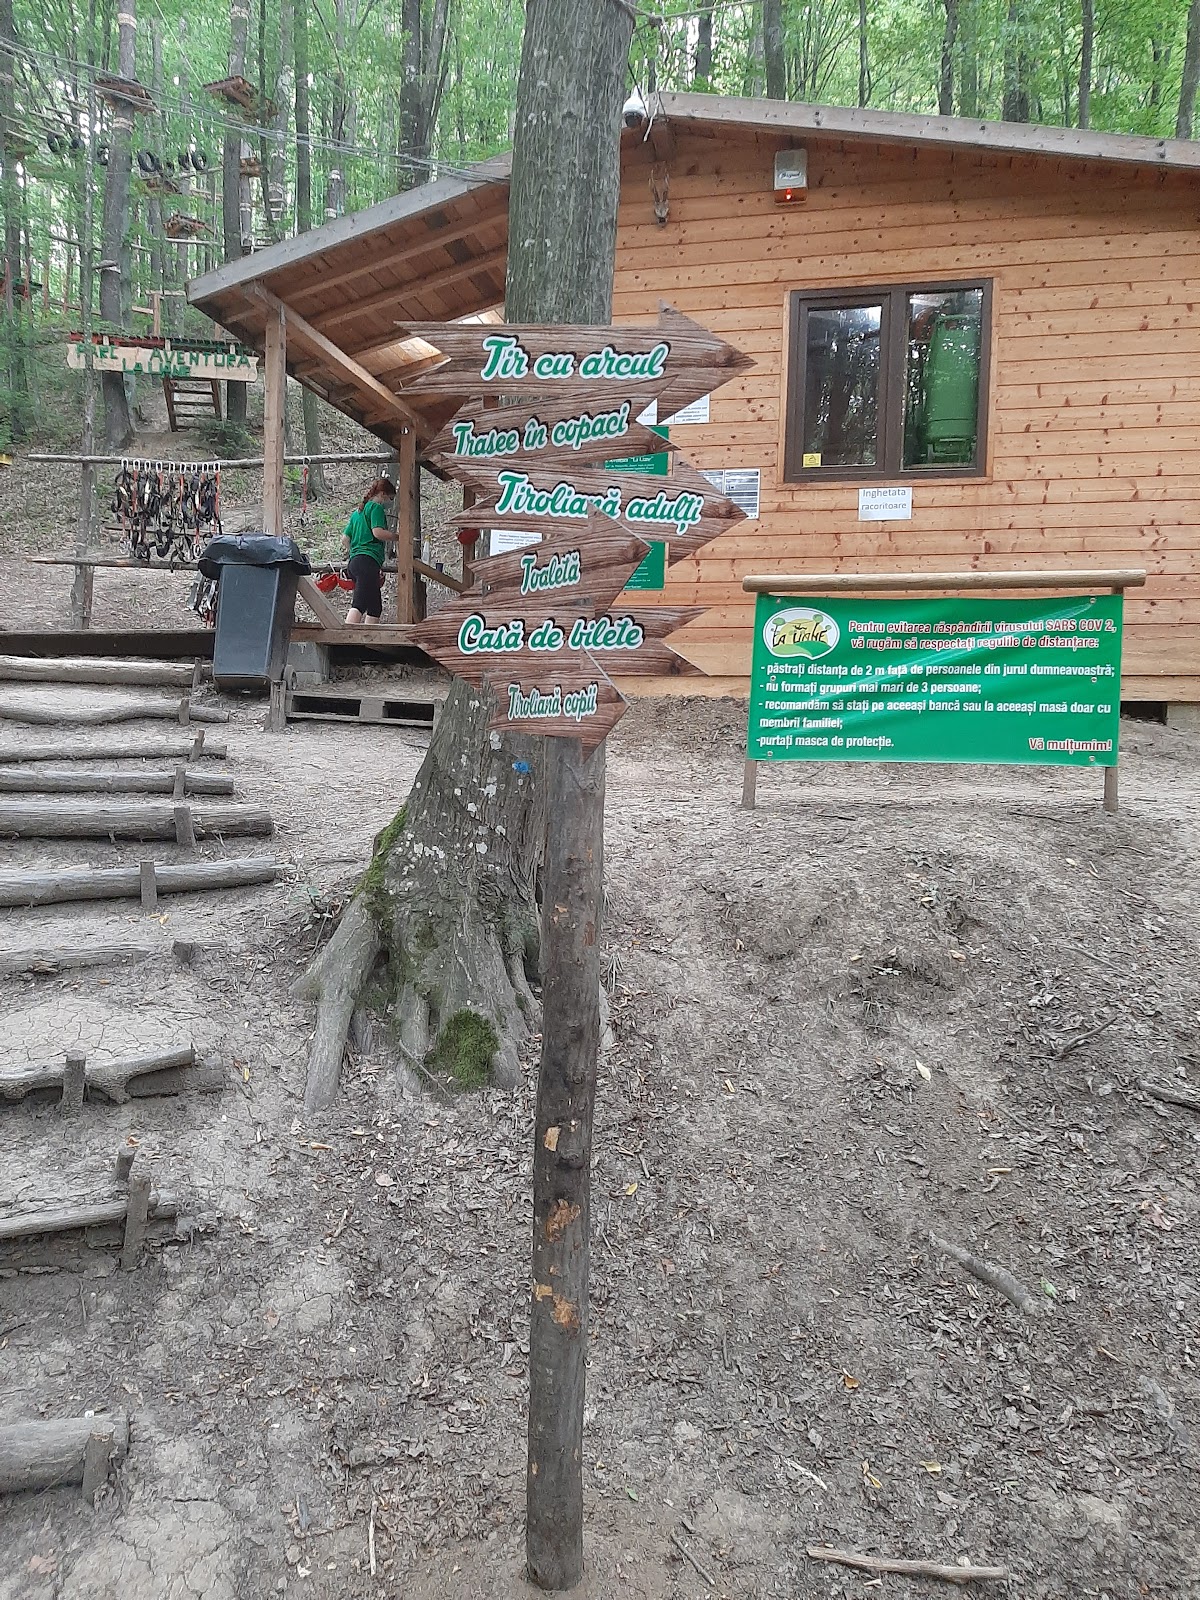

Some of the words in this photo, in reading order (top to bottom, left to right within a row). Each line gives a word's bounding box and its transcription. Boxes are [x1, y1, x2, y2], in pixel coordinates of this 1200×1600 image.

[150, 347, 251, 368] AVENTURA
[482, 337, 529, 380] Tir
[533, 353, 576, 379] cu
[579, 343, 667, 379] arcul
[453, 420, 519, 457] Trasee
[523, 417, 547, 450] în
[551, 403, 631, 450] copaci
[863, 489, 906, 498] Inghetata
[625, 490, 704, 535] adulți
[862, 502, 907, 510] racoritoare
[520, 551, 580, 595] Toaletă
[458, 615, 524, 654] Casă
[528, 619, 564, 651] de
[568, 615, 643, 651] bilete
[849, 620, 884, 633] Pentru
[887, 621, 931, 633] evitarea
[933, 621, 992, 635] răspândirii
[995, 621, 1044, 632] virusului
[1046, 619, 1077, 631] SARS
[1079, 619, 1103, 631] COV
[1105, 619, 1117, 632] 2,
[772, 625, 786, 647] LA
[851, 636, 864, 649] vă
[867, 637, 902, 651] rugăm
[904, 637, 917, 649] să
[920, 637, 975, 651] respectați
[977, 636, 1020, 649] regulile
[1022, 636, 1035, 648] de
[1038, 636, 1099, 652] distanțare:
[767, 663, 805, 678] păstrați
[808, 664, 848, 679] distanța
[851, 665, 863, 675] de
[865, 665, 873, 675] 2
[875, 667, 885, 675] m
[887, 664, 907, 678] față
[910, 665, 923, 675] de
[926, 664, 981, 676] persoanele
[984, 664, 1000, 675] din
[1003, 664, 1027, 676] jurul
[1030, 664, 1115, 677] dumneavoastră;
[766, 682, 778, 691] nu
[781, 681, 817, 695] formați
[820, 682, 856, 695] grupuri
[859, 682, 878, 692] mai
[881, 682, 903, 692] mari
[906, 682, 919, 692] de
[921, 682, 928, 692] 3
[930, 682, 981, 694] persoane;
[508, 683, 561, 720] Tiroliană
[563, 683, 598, 722] copii
[765, 699, 829, 710] recomandăm
[832, 700, 844, 710] să
[846, 700, 869, 714] stați
[871, 702, 885, 712] pe
[887, 700, 926, 714] aceeași
[929, 700, 959, 711] bancă
[963, 702, 981, 711] sau
[984, 701, 994, 711] la
[997, 701, 1036, 716] aceeași
[1039, 702, 1067, 712] masă
[1071, 702, 1094, 712] doar
[1097, 704, 1111, 713] cu
[760, 717, 800, 728] membrii
[802, 717, 843, 729] familiei;
[795, 737, 828, 746] masca
[831, 736, 844, 746] de
[846, 736, 894, 750] protecție.
[1029, 738, 1044, 750] Vă
[1047, 739, 1112, 754] mulțumim!
